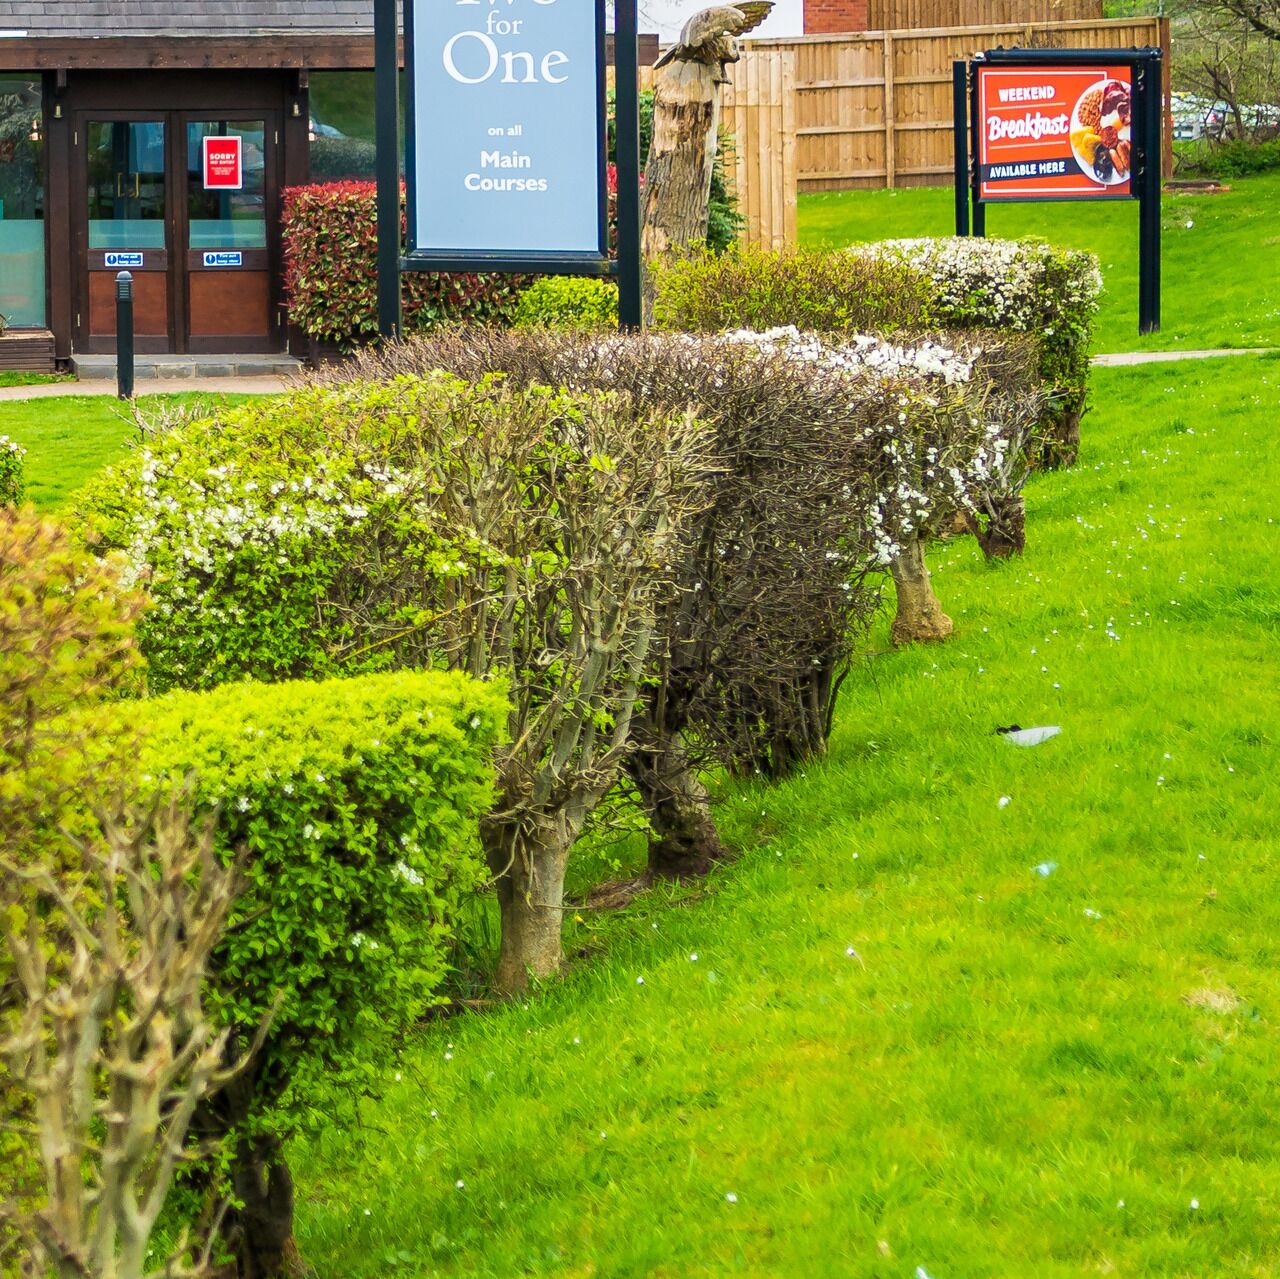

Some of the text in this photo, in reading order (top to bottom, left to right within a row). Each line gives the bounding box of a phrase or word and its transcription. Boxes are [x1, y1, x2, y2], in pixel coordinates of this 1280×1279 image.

[486, 10, 523, 35] for
[443, 30, 569, 85] One
[998, 85, 1056, 102] WEEKEND
[487, 124, 522, 136] on all
[987, 111, 1070, 142] Breakfast
[480, 150, 532, 168] Main
[989, 160, 1066, 178] AVAILABLE HERE
[463, 173, 548, 192] Courses
